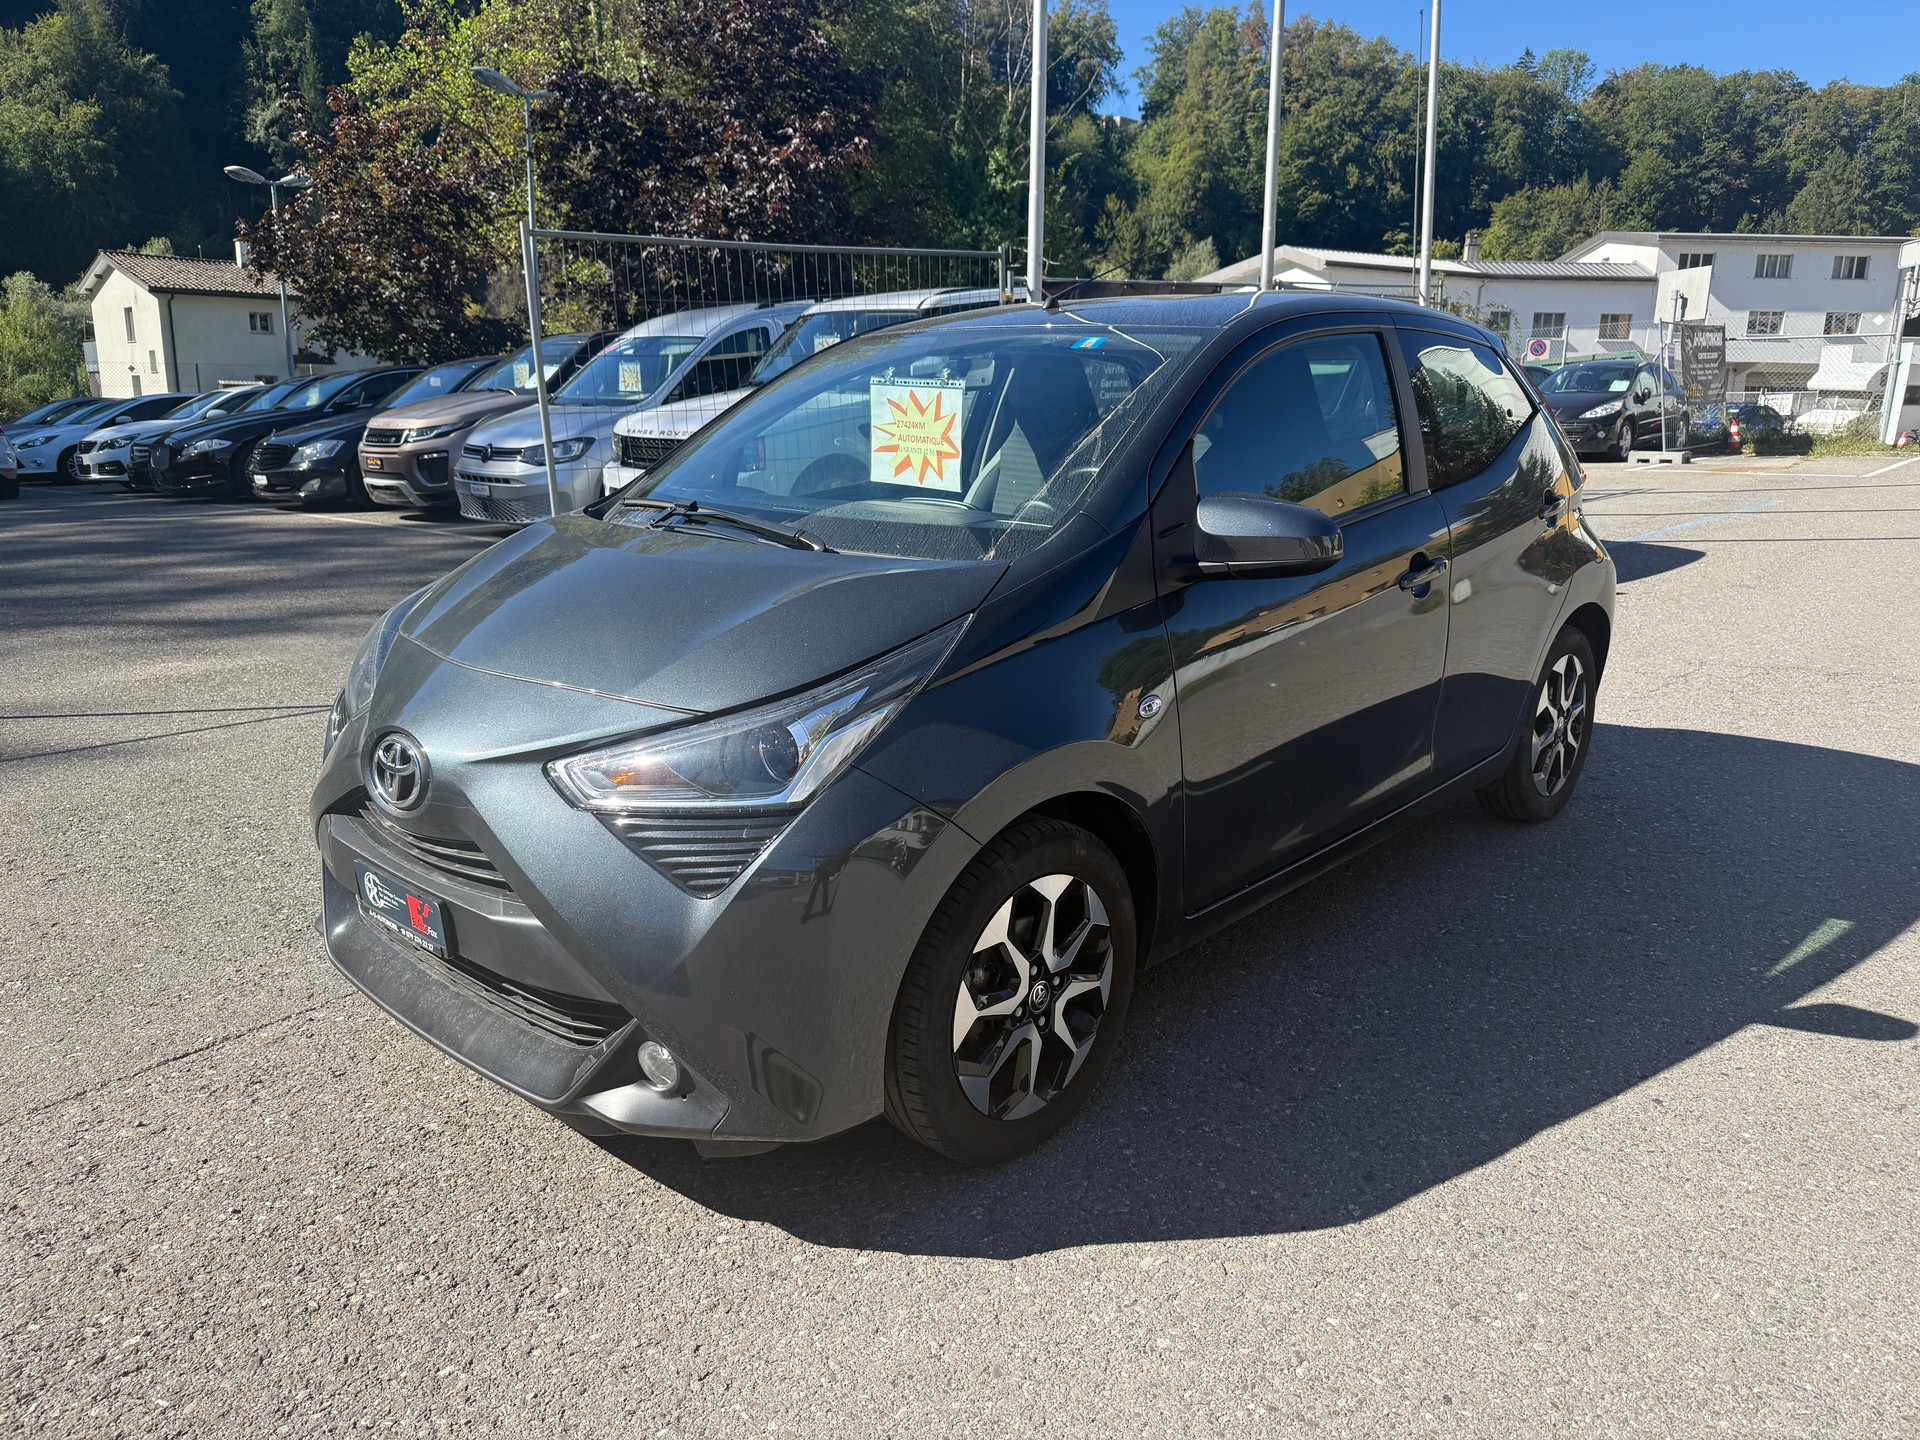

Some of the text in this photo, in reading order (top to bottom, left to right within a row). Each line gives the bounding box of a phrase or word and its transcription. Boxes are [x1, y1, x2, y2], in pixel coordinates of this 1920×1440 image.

[1103, 365, 1125, 374] Vente
[1100, 379, 1128, 388] Garantie
[896, 420, 925, 430] 27424KM
[898, 434, 945, 446] AUTOMATIQUE
